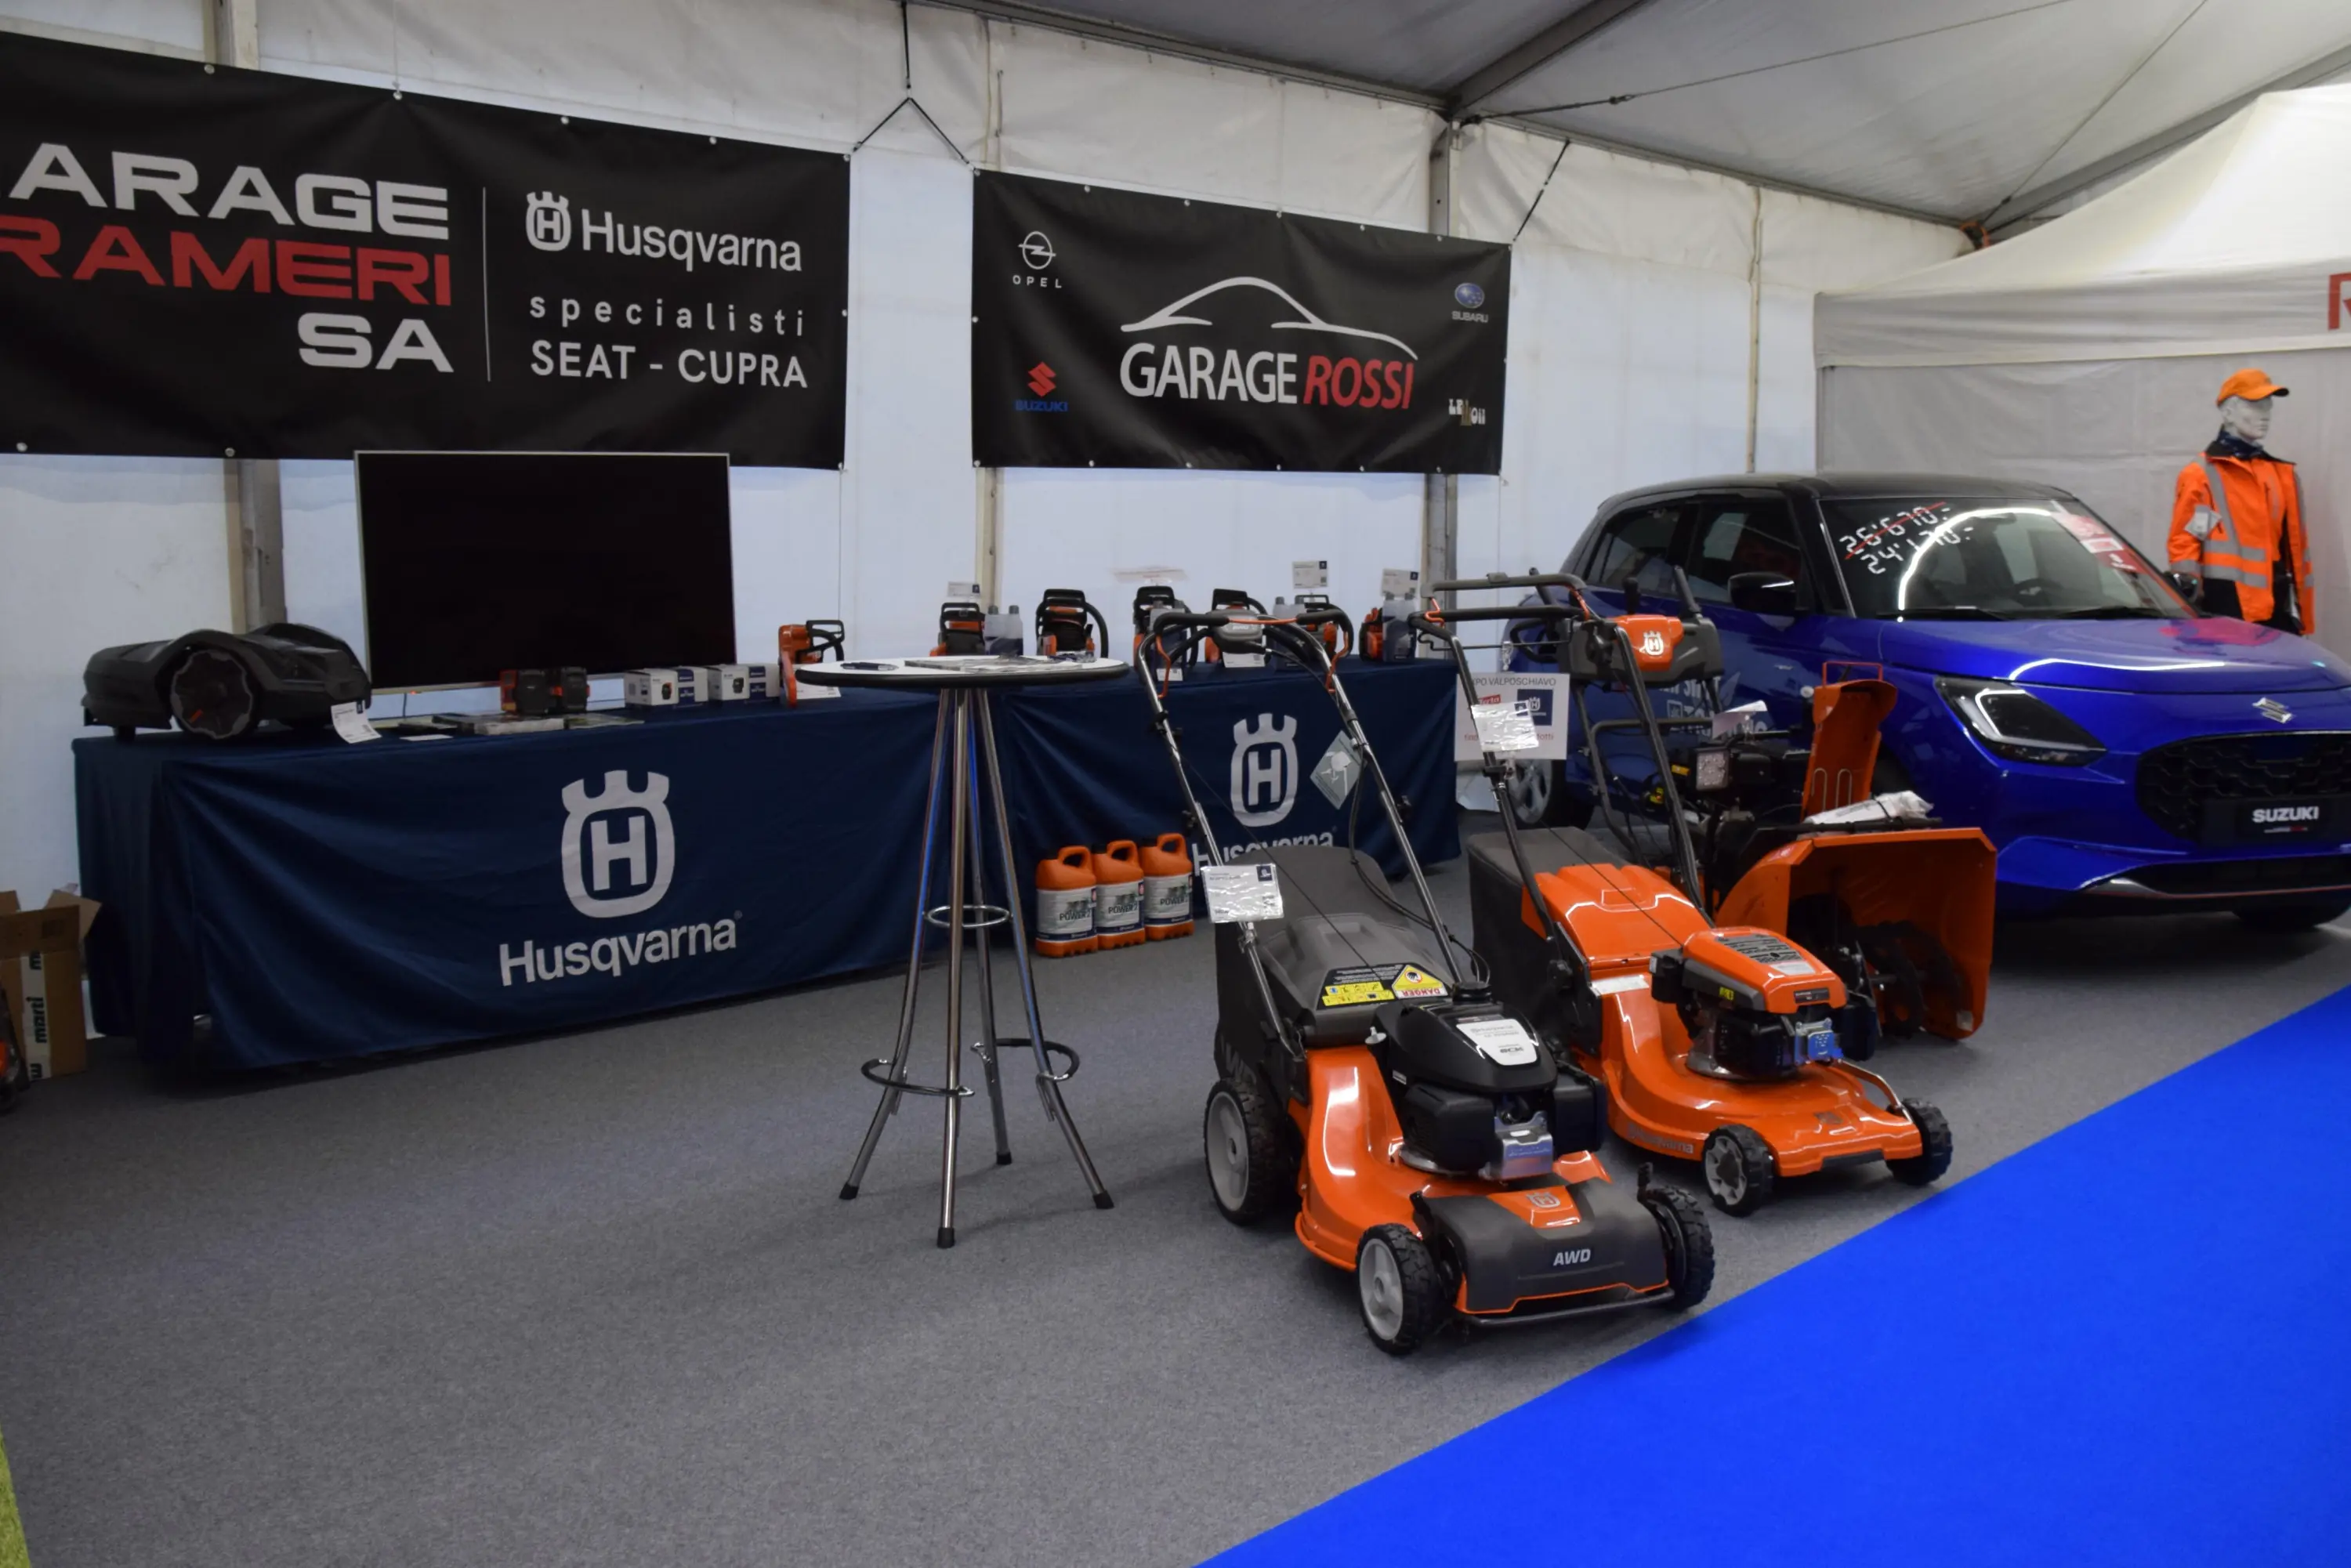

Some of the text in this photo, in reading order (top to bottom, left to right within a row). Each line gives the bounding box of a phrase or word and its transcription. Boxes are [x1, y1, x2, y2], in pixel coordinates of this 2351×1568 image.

[9, 142, 449, 241] ARAGE
[0, 214, 451, 306] RAMERI
[581, 208, 802, 273] Husqvarna
[1012, 274, 1062, 289] OPEL
[530, 296, 803, 337] specialisti
[1451, 310, 1489, 323] SUBARU
[298, 312, 455, 373] SA
[531, 339, 636, 380] SEAT
[678, 349, 808, 389] CUPRA
[1120, 342, 1414, 410] GARAGE ROSSI
[1488, 677, 1556, 686] VALPOSCHIAVO
[2251, 806, 2320, 824] SUZUKI
[499, 918, 737, 987] Husqvarna
[1401, 987, 1440, 998] DANGER
[1552, 1248, 1592, 1267] AWD
